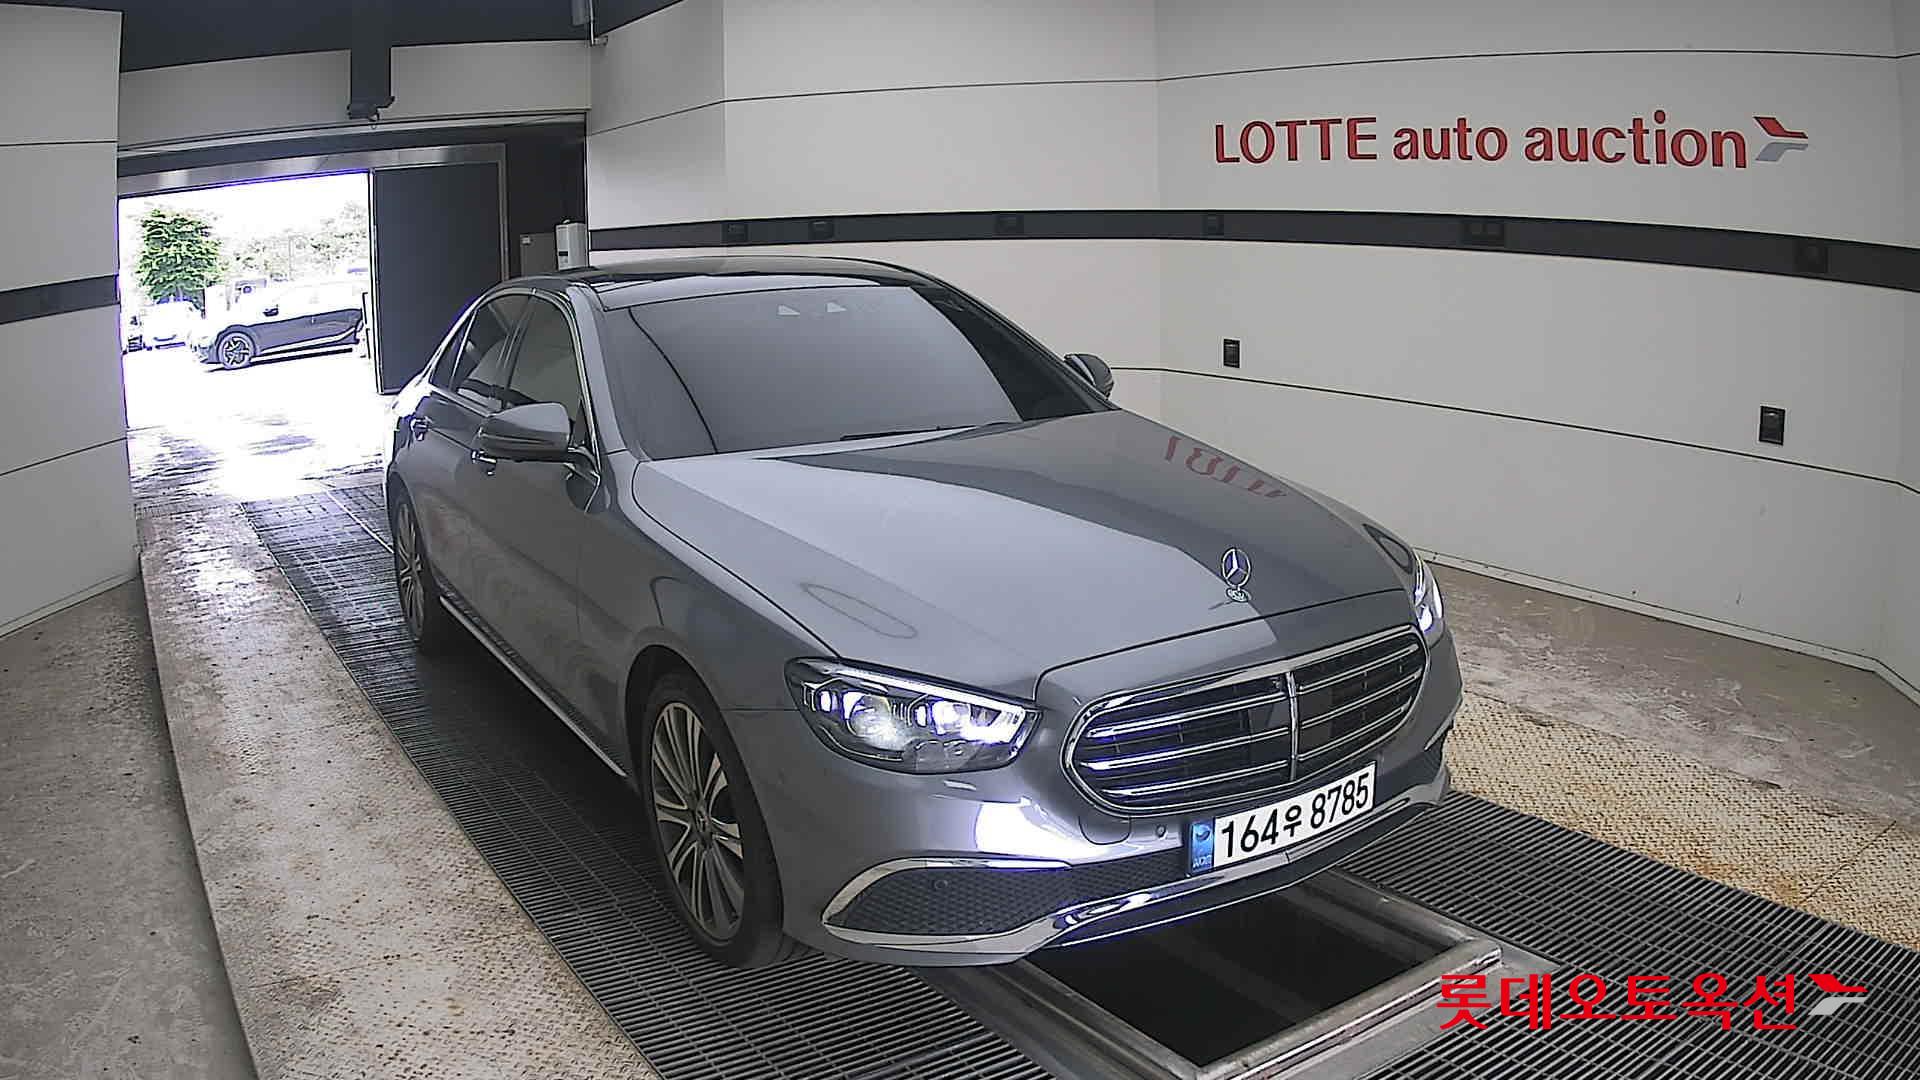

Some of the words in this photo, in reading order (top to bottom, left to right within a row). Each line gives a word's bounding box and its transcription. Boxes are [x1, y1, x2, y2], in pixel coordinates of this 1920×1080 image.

[1214, 117, 1378, 164] LOTTE
[1393, 117, 1508, 162] auto
[1525, 110, 1748, 169] auction
[1221, 805, 1302, 858] 164우
[1310, 772, 1370, 830] 8785
